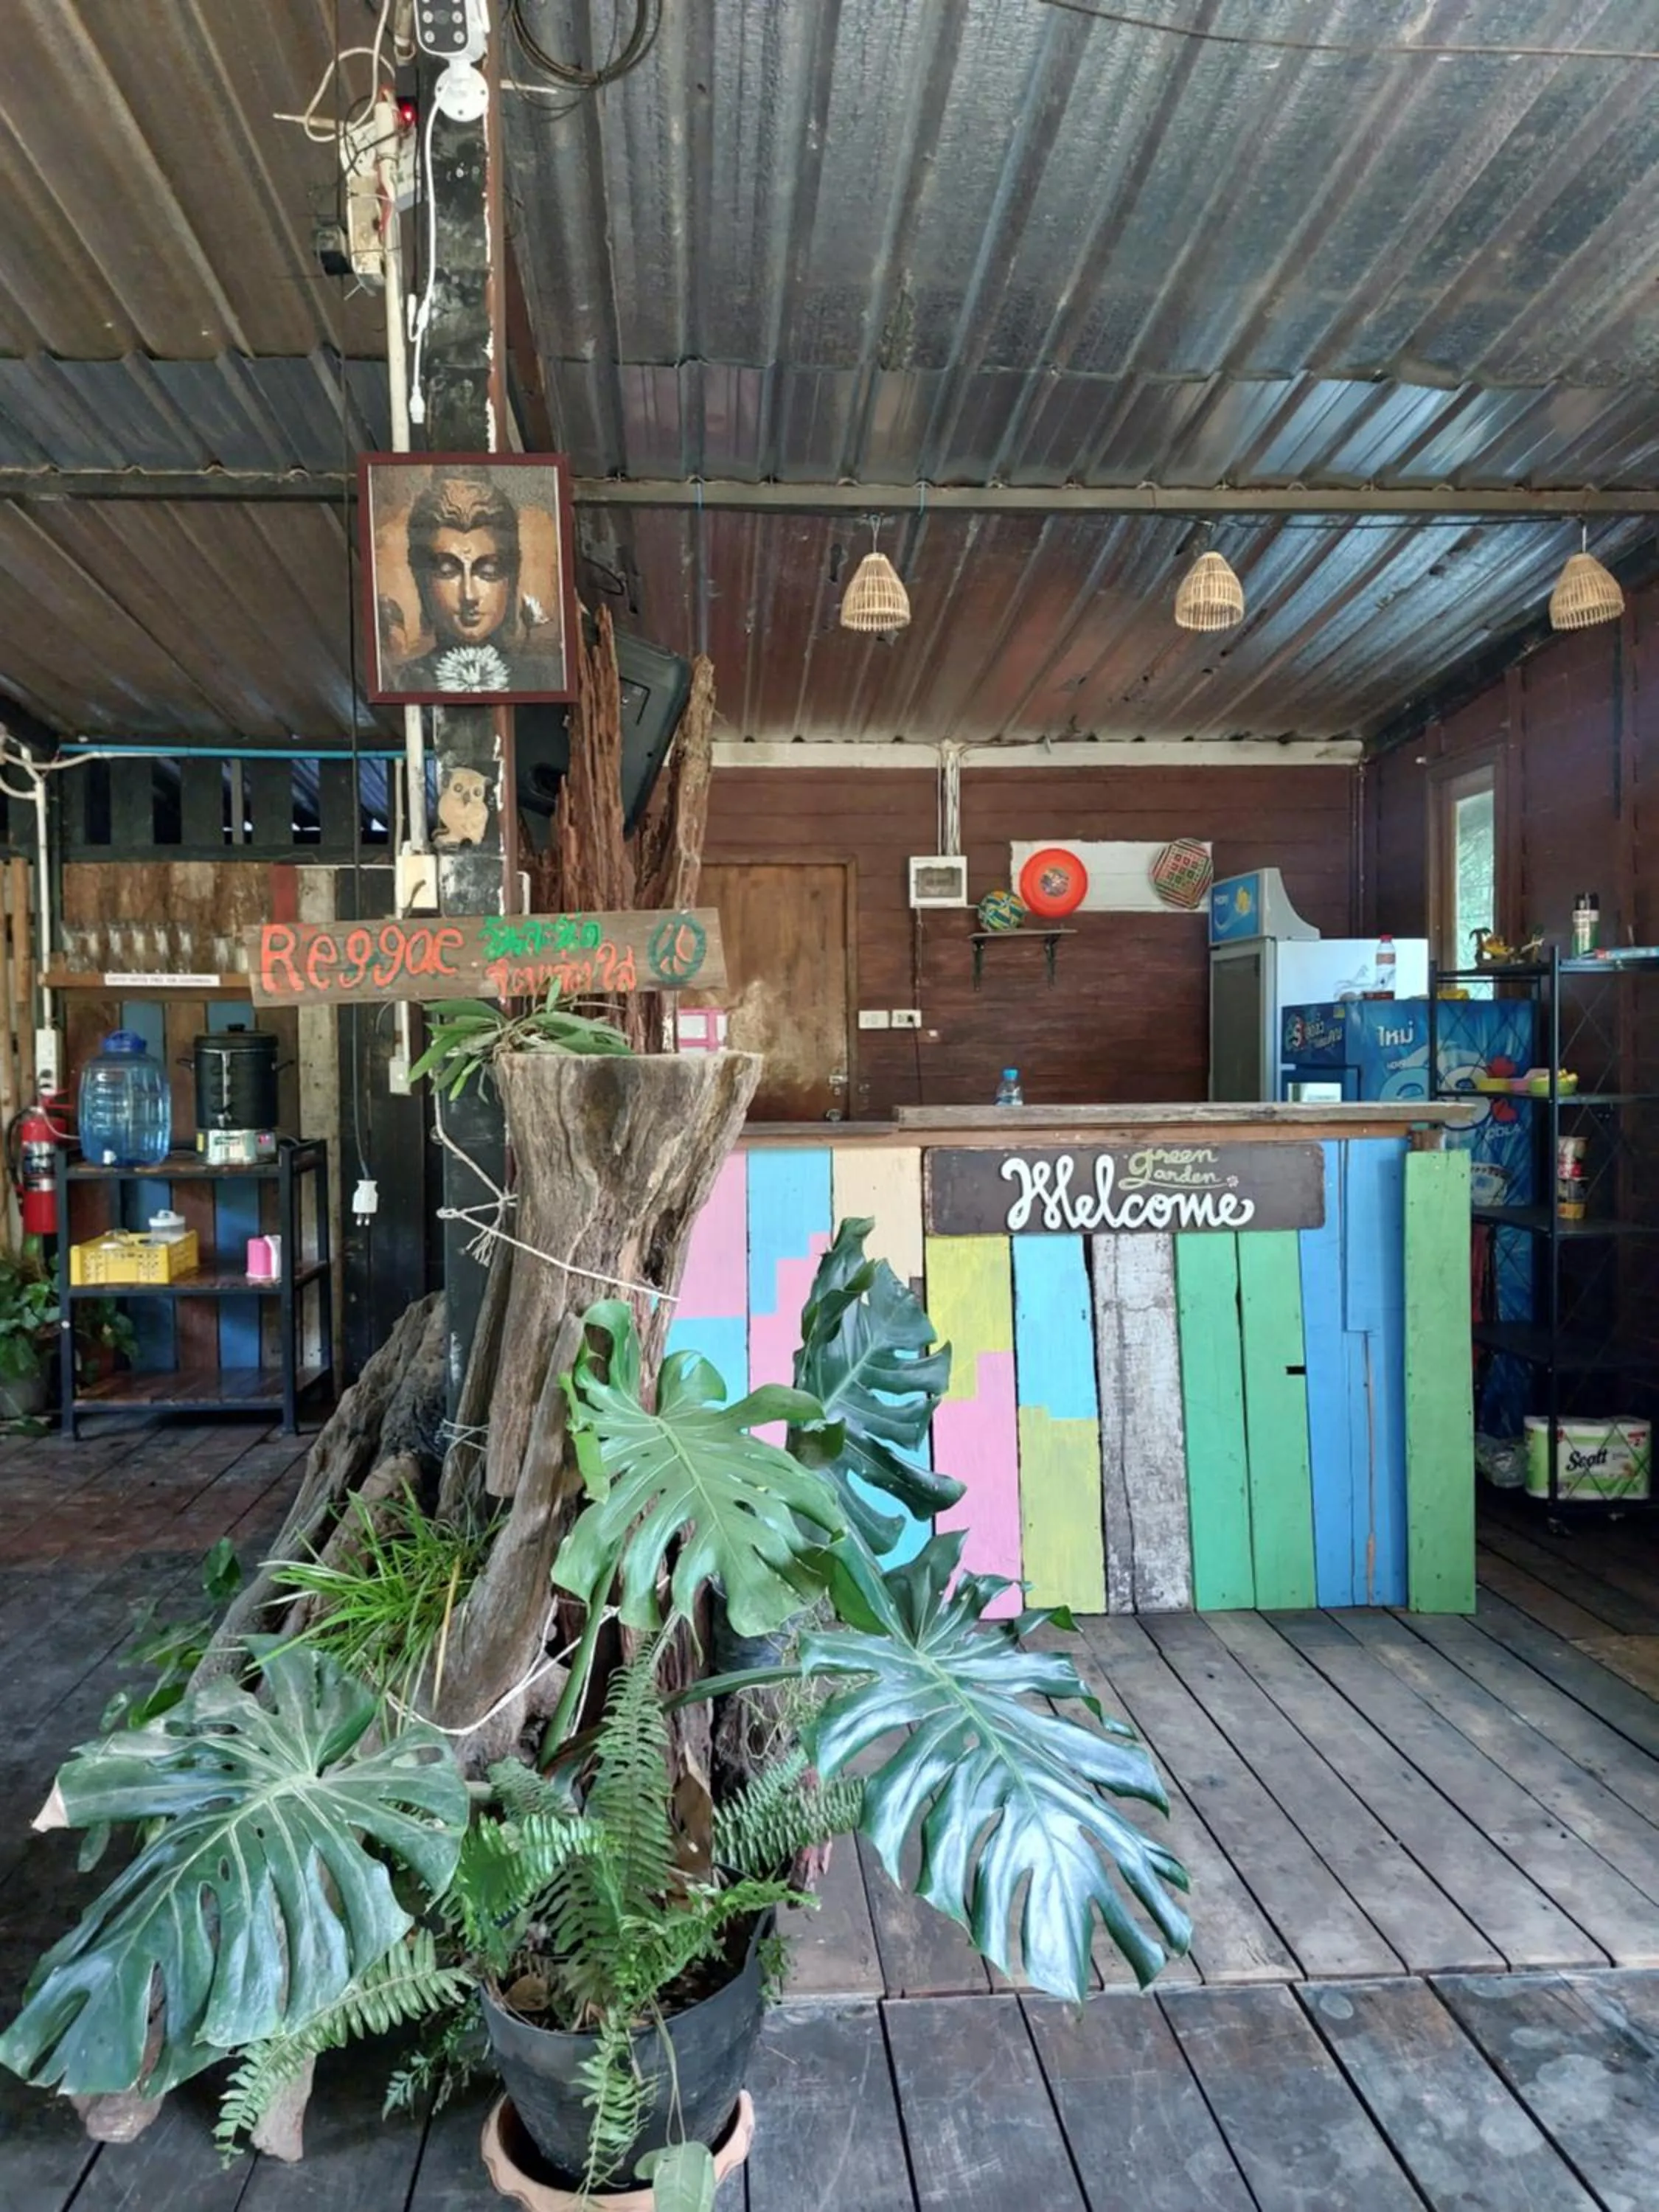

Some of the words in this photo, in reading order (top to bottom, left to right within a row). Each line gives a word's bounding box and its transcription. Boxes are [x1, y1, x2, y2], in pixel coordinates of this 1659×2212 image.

[261, 923, 465, 995] Reggae
[1377, 1020, 1414, 1047] ใหม่
[1001, 1153, 1255, 1231] Welcome
[1566, 1448, 1607, 1471] Scott
